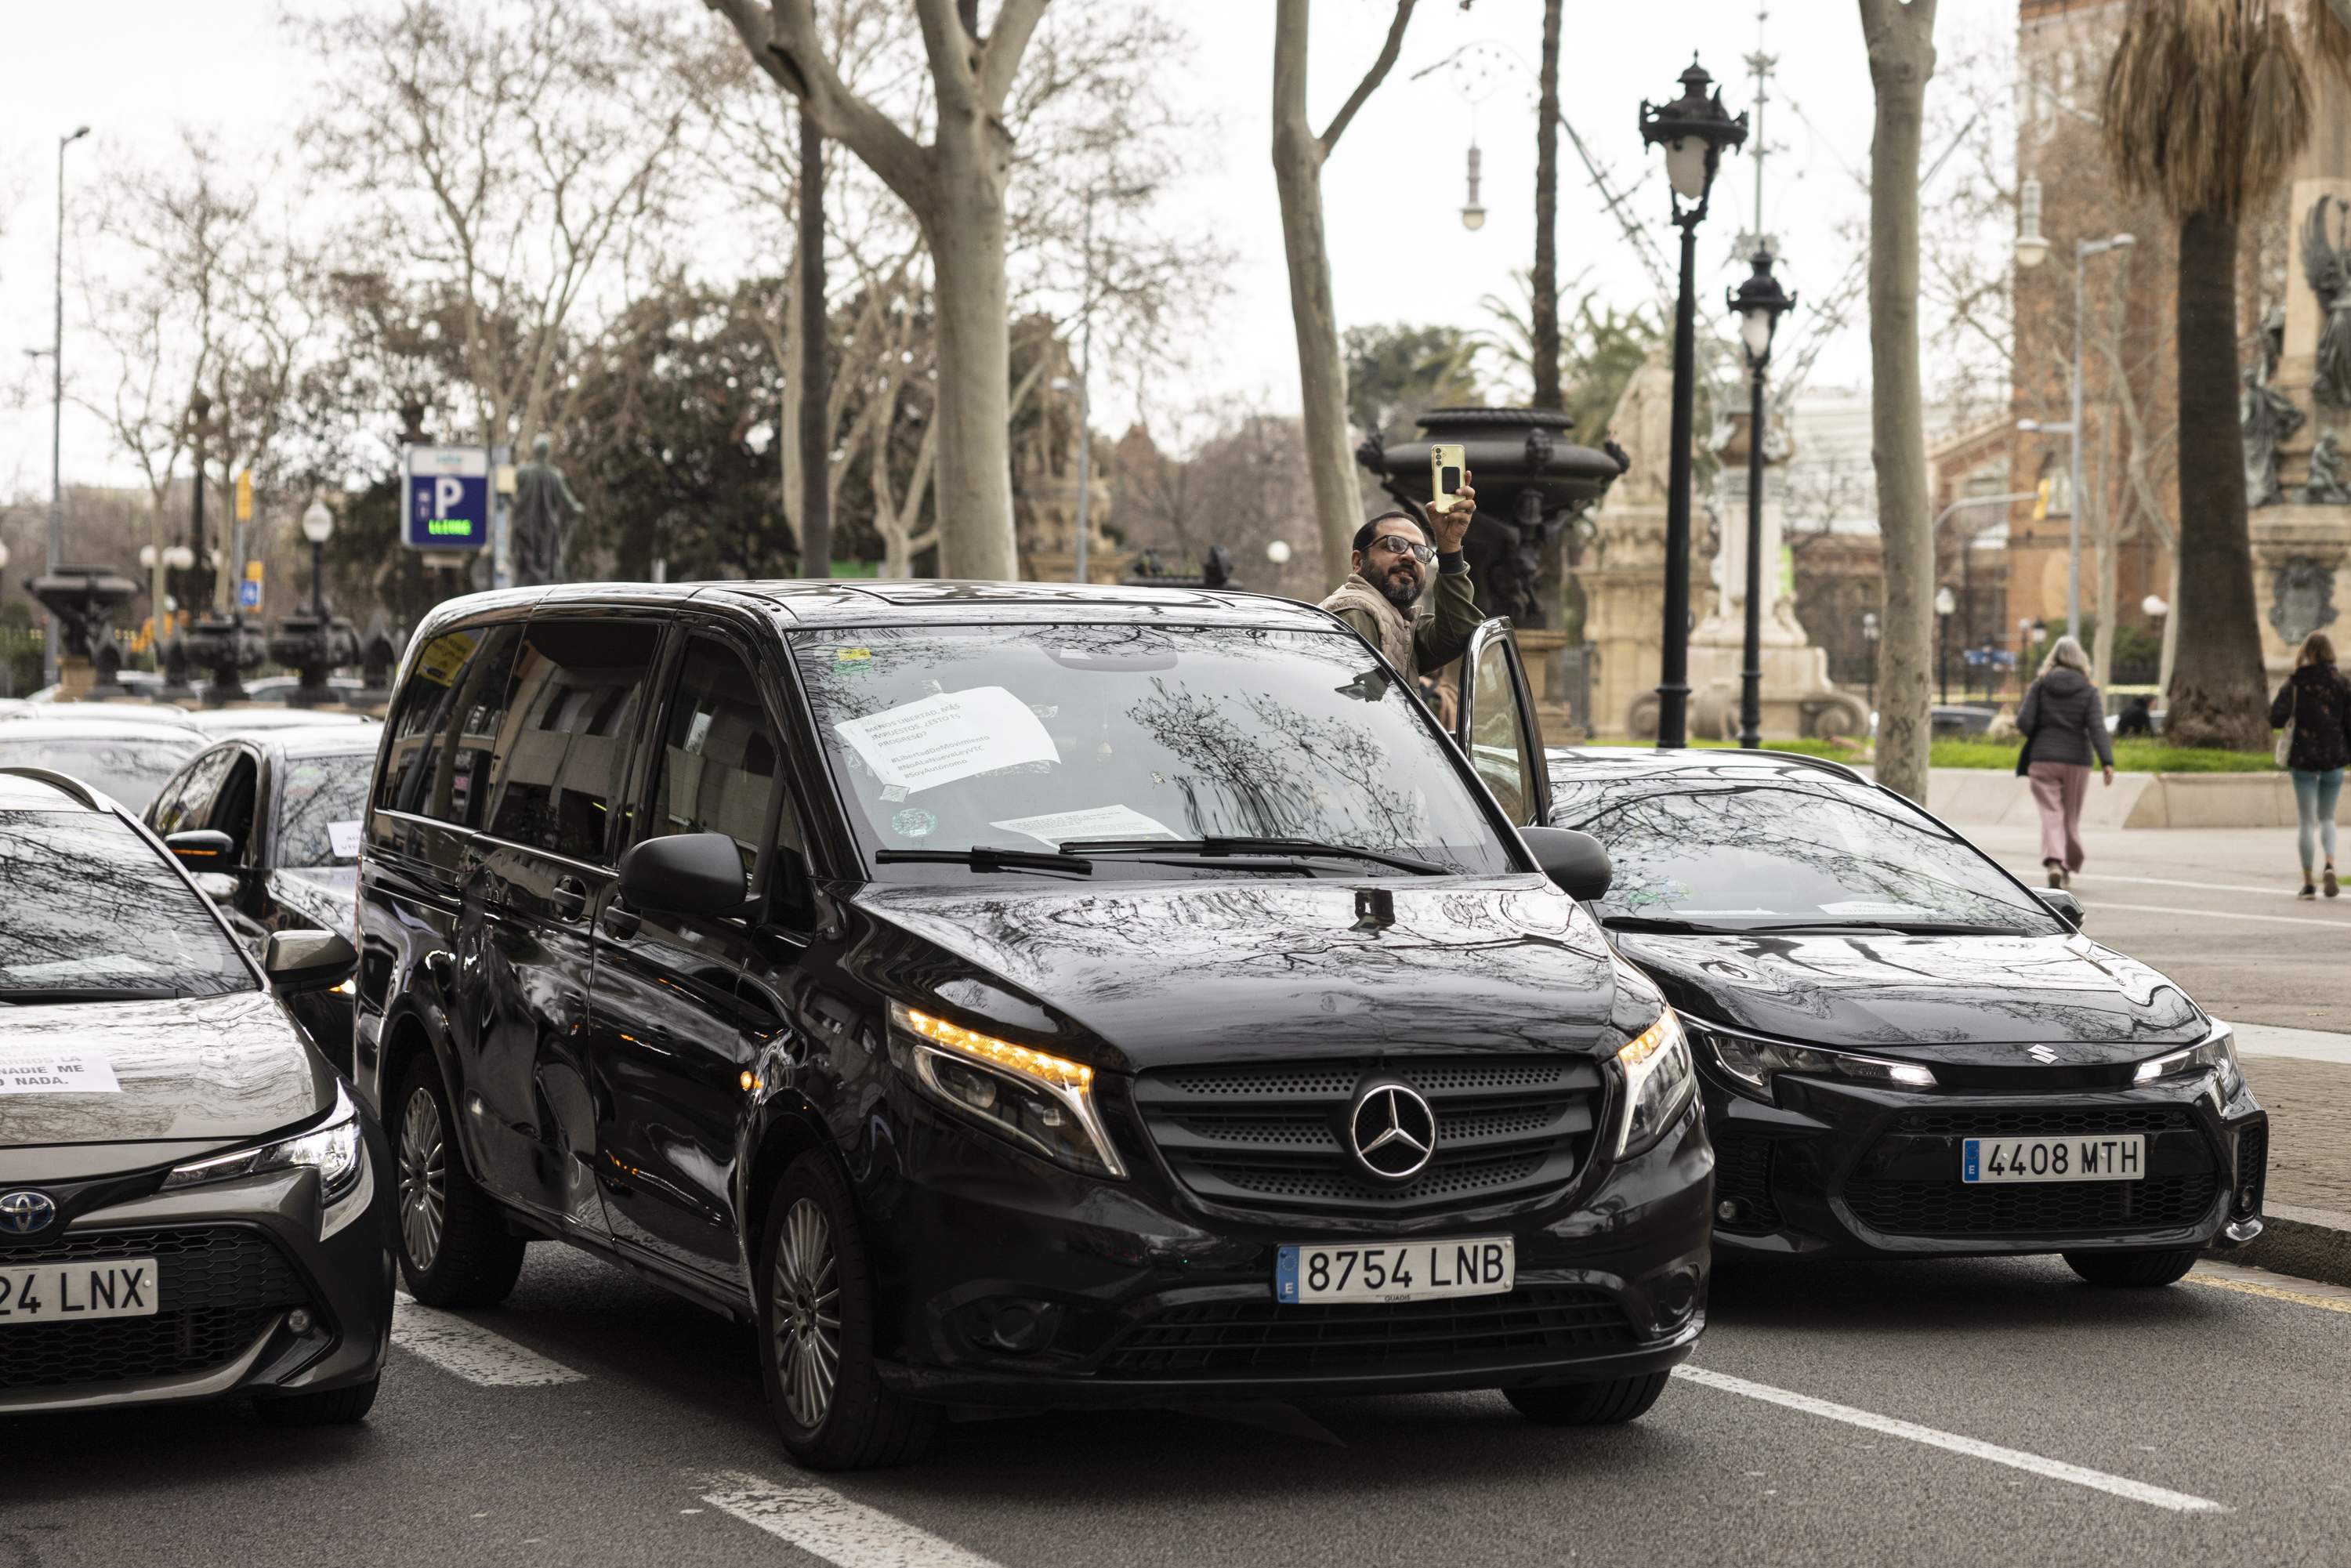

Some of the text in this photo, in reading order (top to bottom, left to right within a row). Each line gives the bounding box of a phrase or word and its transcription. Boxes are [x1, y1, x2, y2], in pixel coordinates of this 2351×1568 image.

[435, 477, 464, 519] P
[865, 720, 897, 733] MENOS
[898, 709, 940, 725] LIBERTAD,
[878, 731, 928, 748] PROGRESO?
[891, 734, 990, 763] #LibertadDeMovimiento
[15, 1077, 69, 1085] NADA.
[1969, 1141, 2138, 1175] E 4408 MTH
[1285, 1244, 1504, 1294] E 8754 LNB
[60, 1268, 144, 1312] LNX
